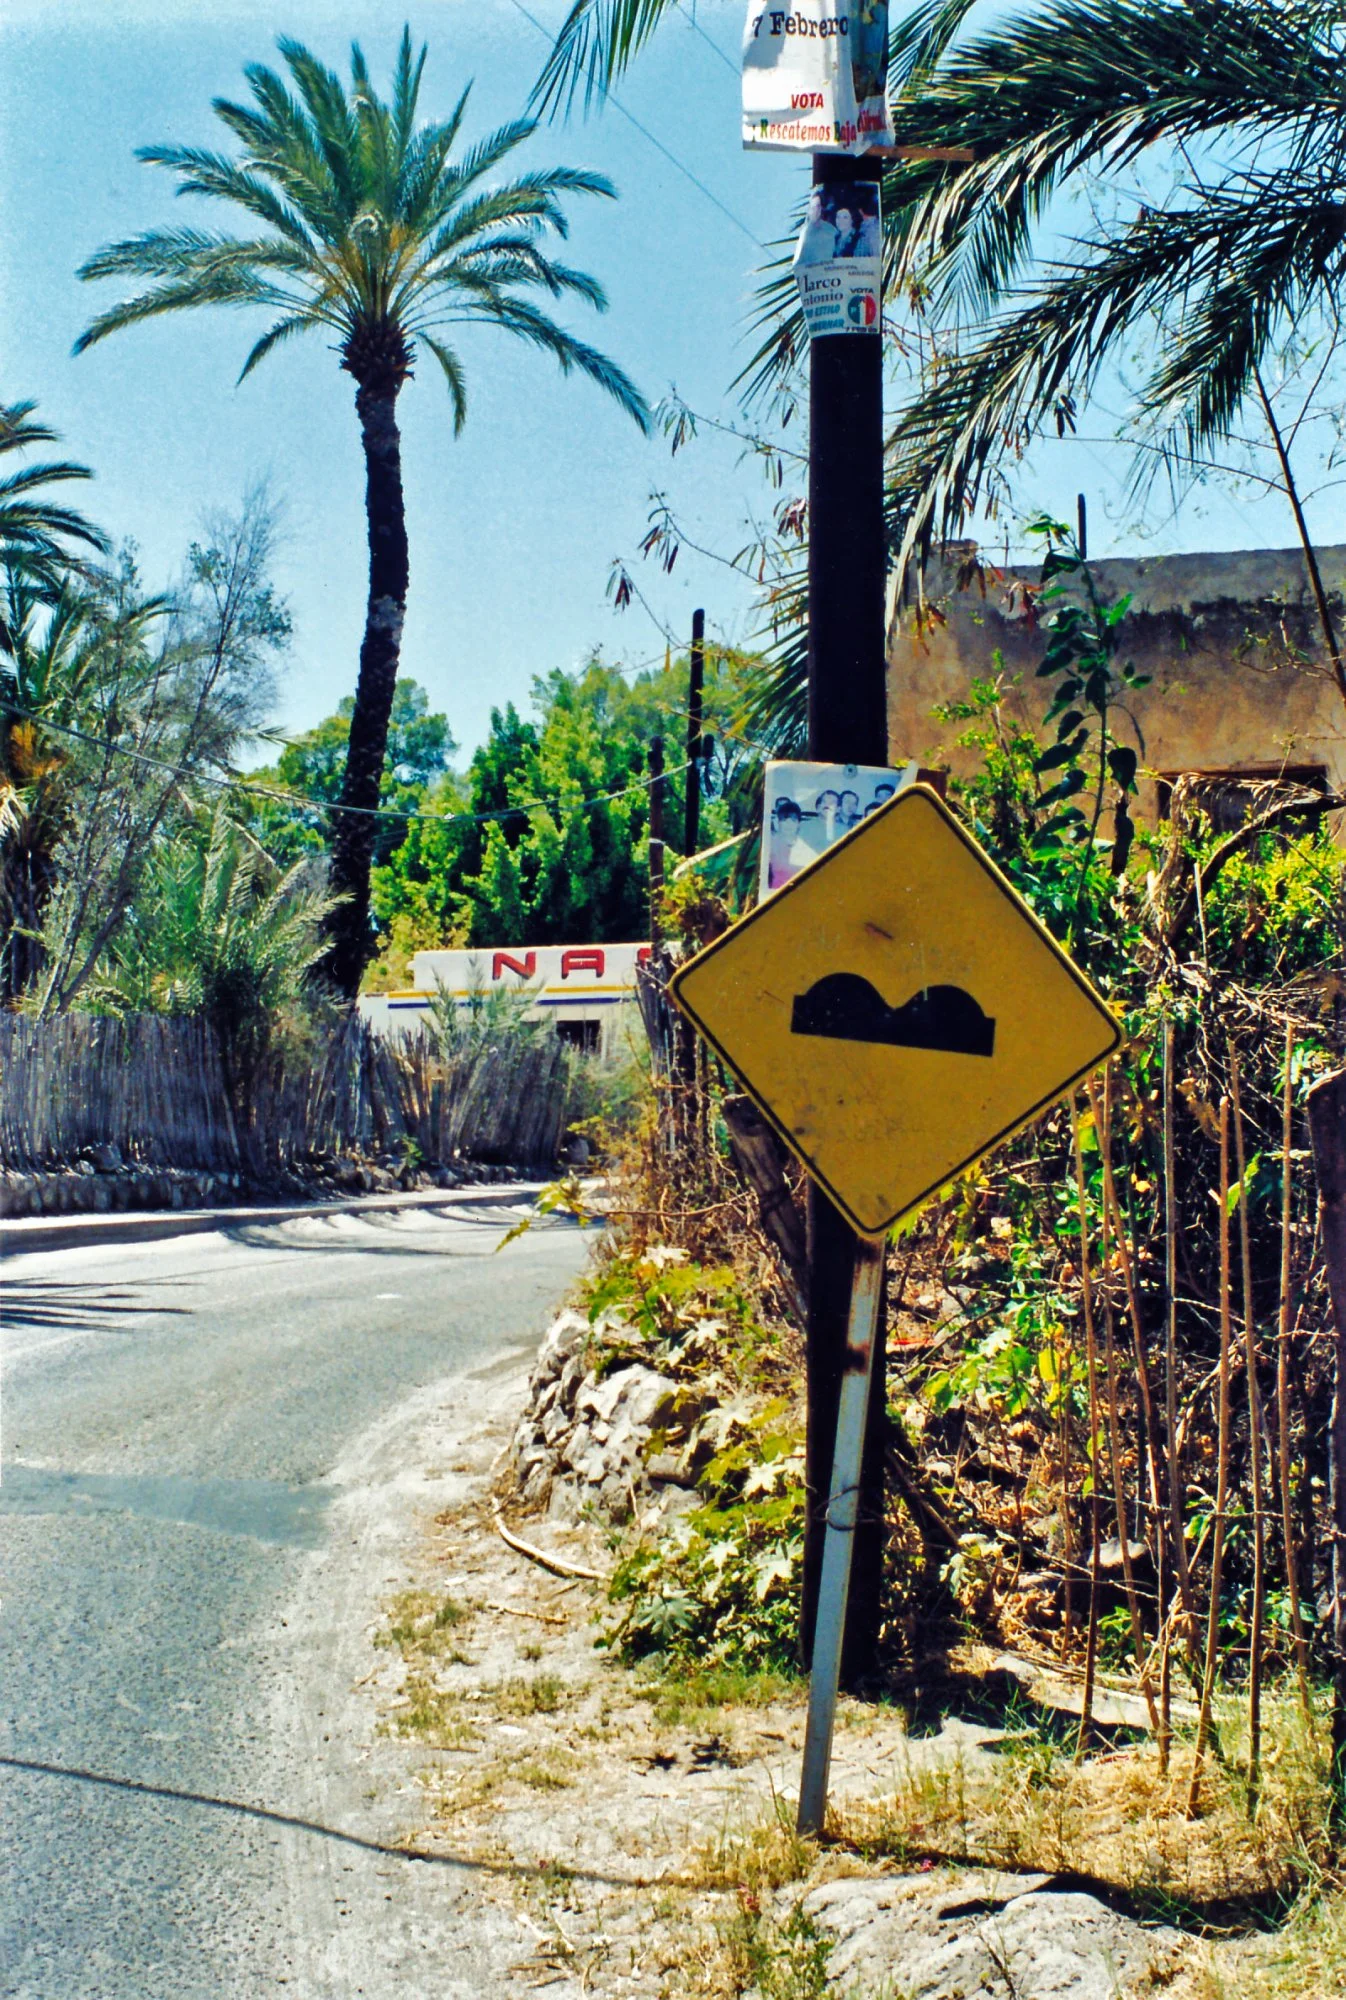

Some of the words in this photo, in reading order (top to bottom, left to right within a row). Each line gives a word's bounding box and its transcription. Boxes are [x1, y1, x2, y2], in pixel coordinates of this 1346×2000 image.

[752, 14, 763, 37] 7
[769, 11, 849, 38] Febrero
[791, 93, 824, 109] VOTA
